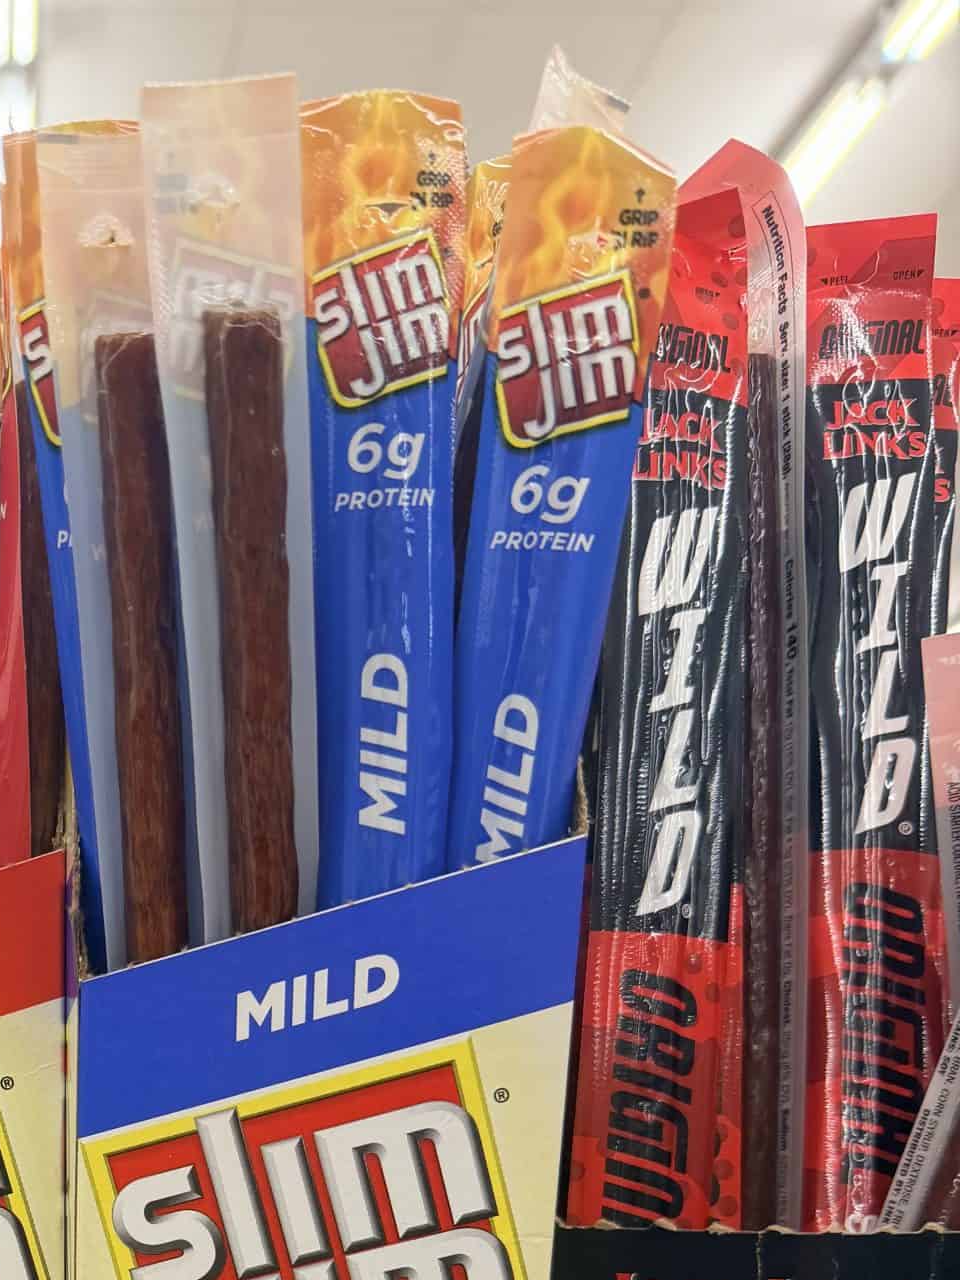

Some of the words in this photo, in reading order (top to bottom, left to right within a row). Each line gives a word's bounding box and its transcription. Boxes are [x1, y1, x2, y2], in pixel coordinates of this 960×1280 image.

[431, 192, 454, 208] RIP
[619, 210, 659, 226] GRIP
[631, 232, 659, 248] RIP
[777, 274, 789, 315] Facts
[346, 424, 425, 479] 6g
[334, 489, 435, 512] PROTEIN
[510, 466, 590, 524] 6g
[490, 532, 595, 553] PROTEIN
[358, 653, 409, 835] MILD
[475, 693, 540, 862] MILD
[234, 954, 400, 1042] MILD
